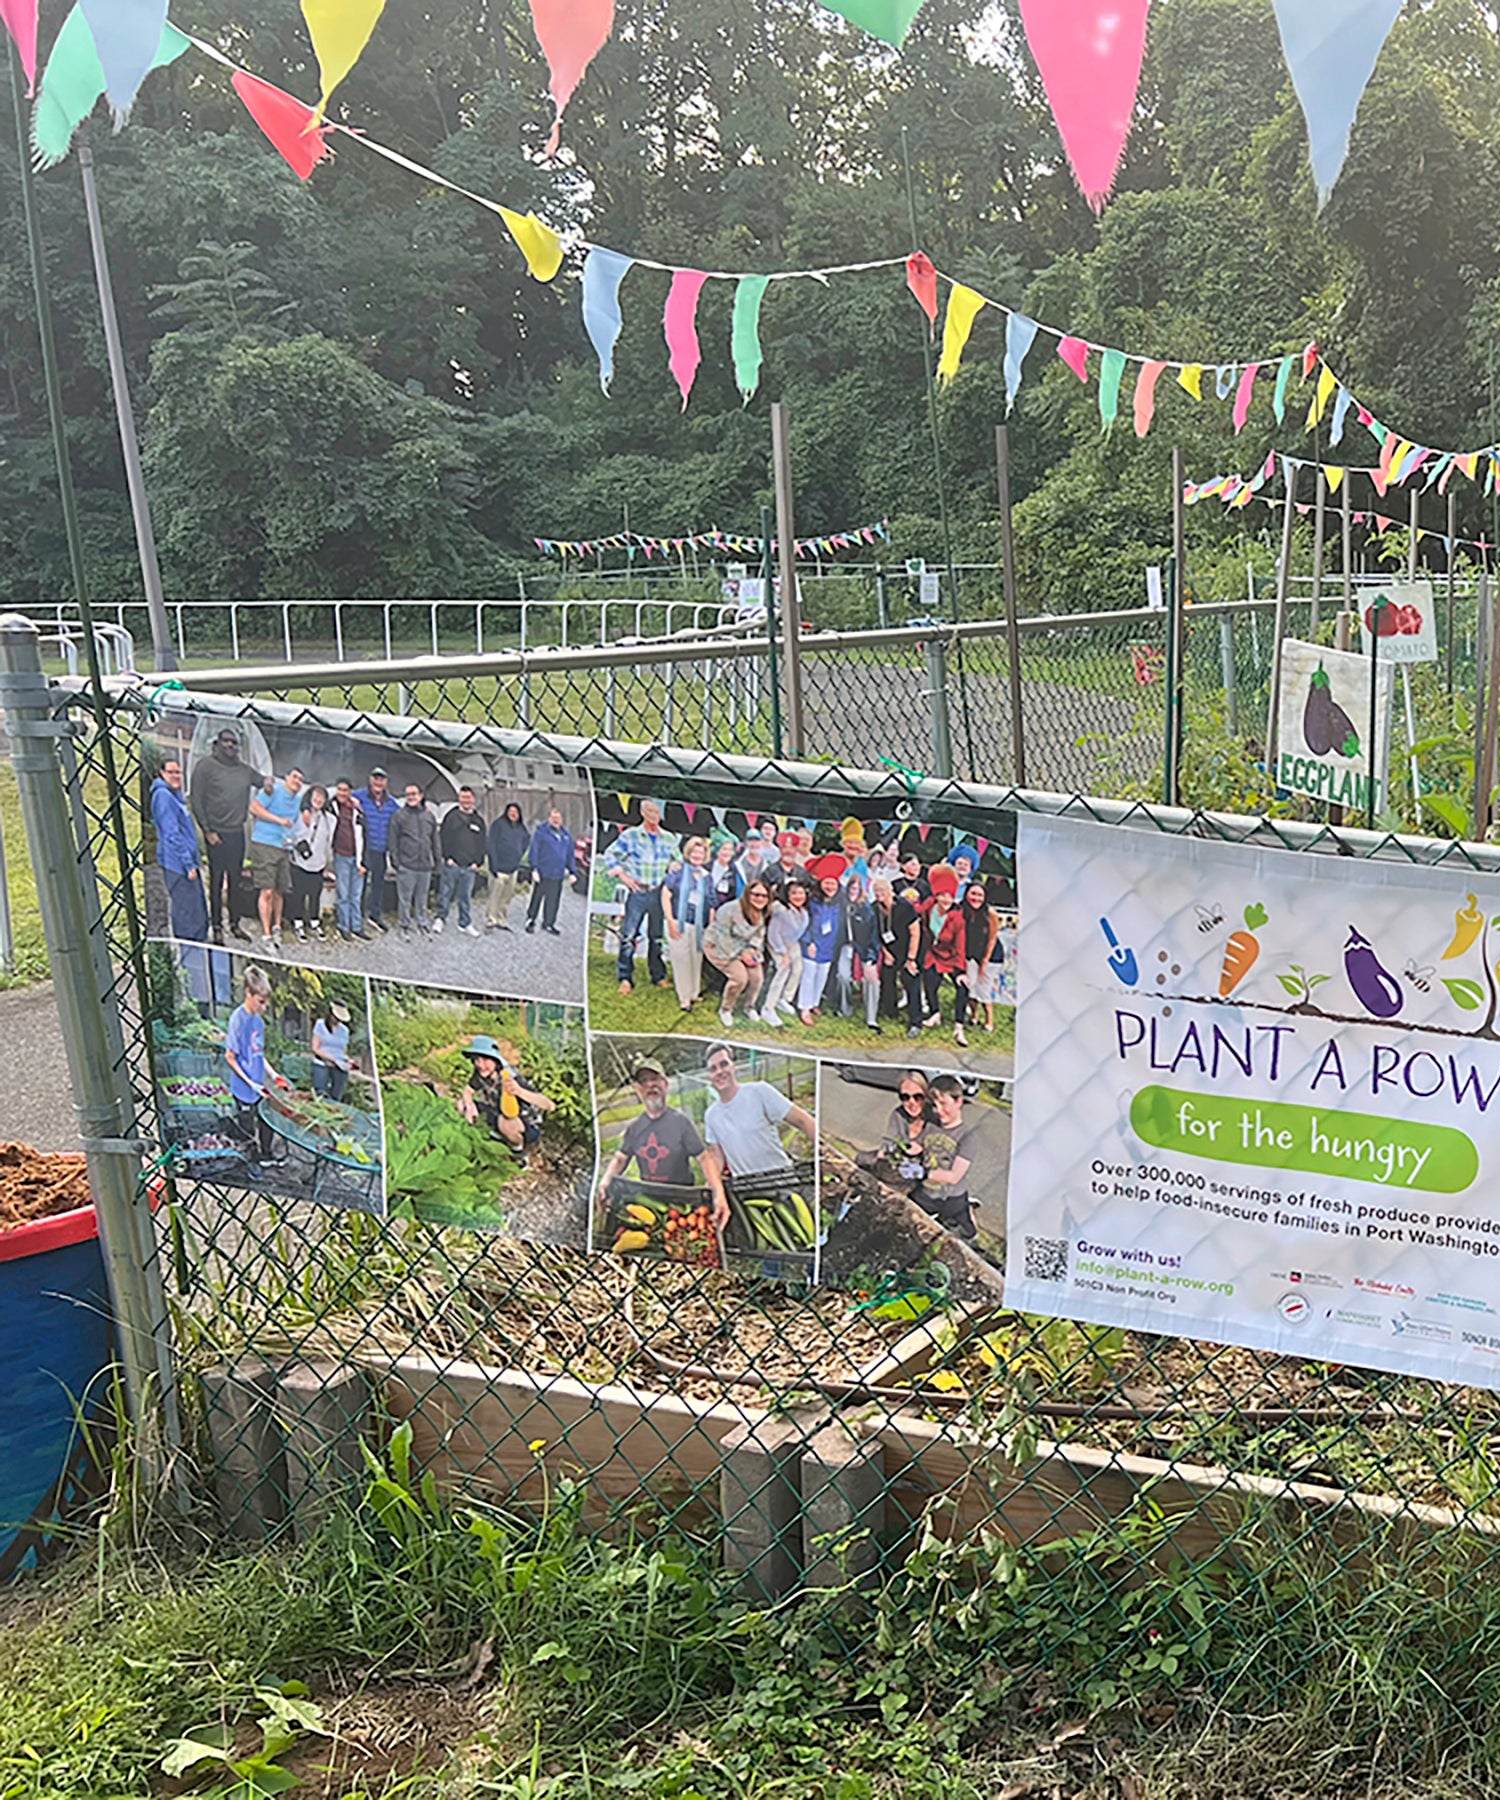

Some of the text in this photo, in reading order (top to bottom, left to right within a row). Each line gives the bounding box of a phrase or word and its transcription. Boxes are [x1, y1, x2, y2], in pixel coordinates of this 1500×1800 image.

[1377, 642, 1429, 660] OMATO
[1115, 1010, 1295, 1081] PLANT
[1310, 1038, 1346, 1090] A
[1176, 1101, 1432, 1184] for the hungry
[1091, 1159, 1133, 1178] Over
[1137, 1165, 1205, 1190] 300,000
[1210, 1181, 1282, 1205] servings
[1287, 1192, 1305, 1206] of
[1310, 1194, 1353, 1215] fresh
[1357, 1204, 1431, 1225] produce
[1091, 1181, 1108, 1195] to
[1113, 1183, 1150, 1202] help
[1155, 1188, 1269, 1223] food-insecure
[1274, 1211, 1339, 1235] families
[1345, 1222, 1361, 1237] in
[1366, 1225, 1403, 1241] Port
[1075, 1260, 1235, 1296] info@plant-a-row.org
[1077, 1240, 1182, 1268] Grow with us!
[1106, 1283, 1126, 1295] Non
[1128, 1286, 1155, 1300] Profit
[1156, 1291, 1177, 1303] Org
